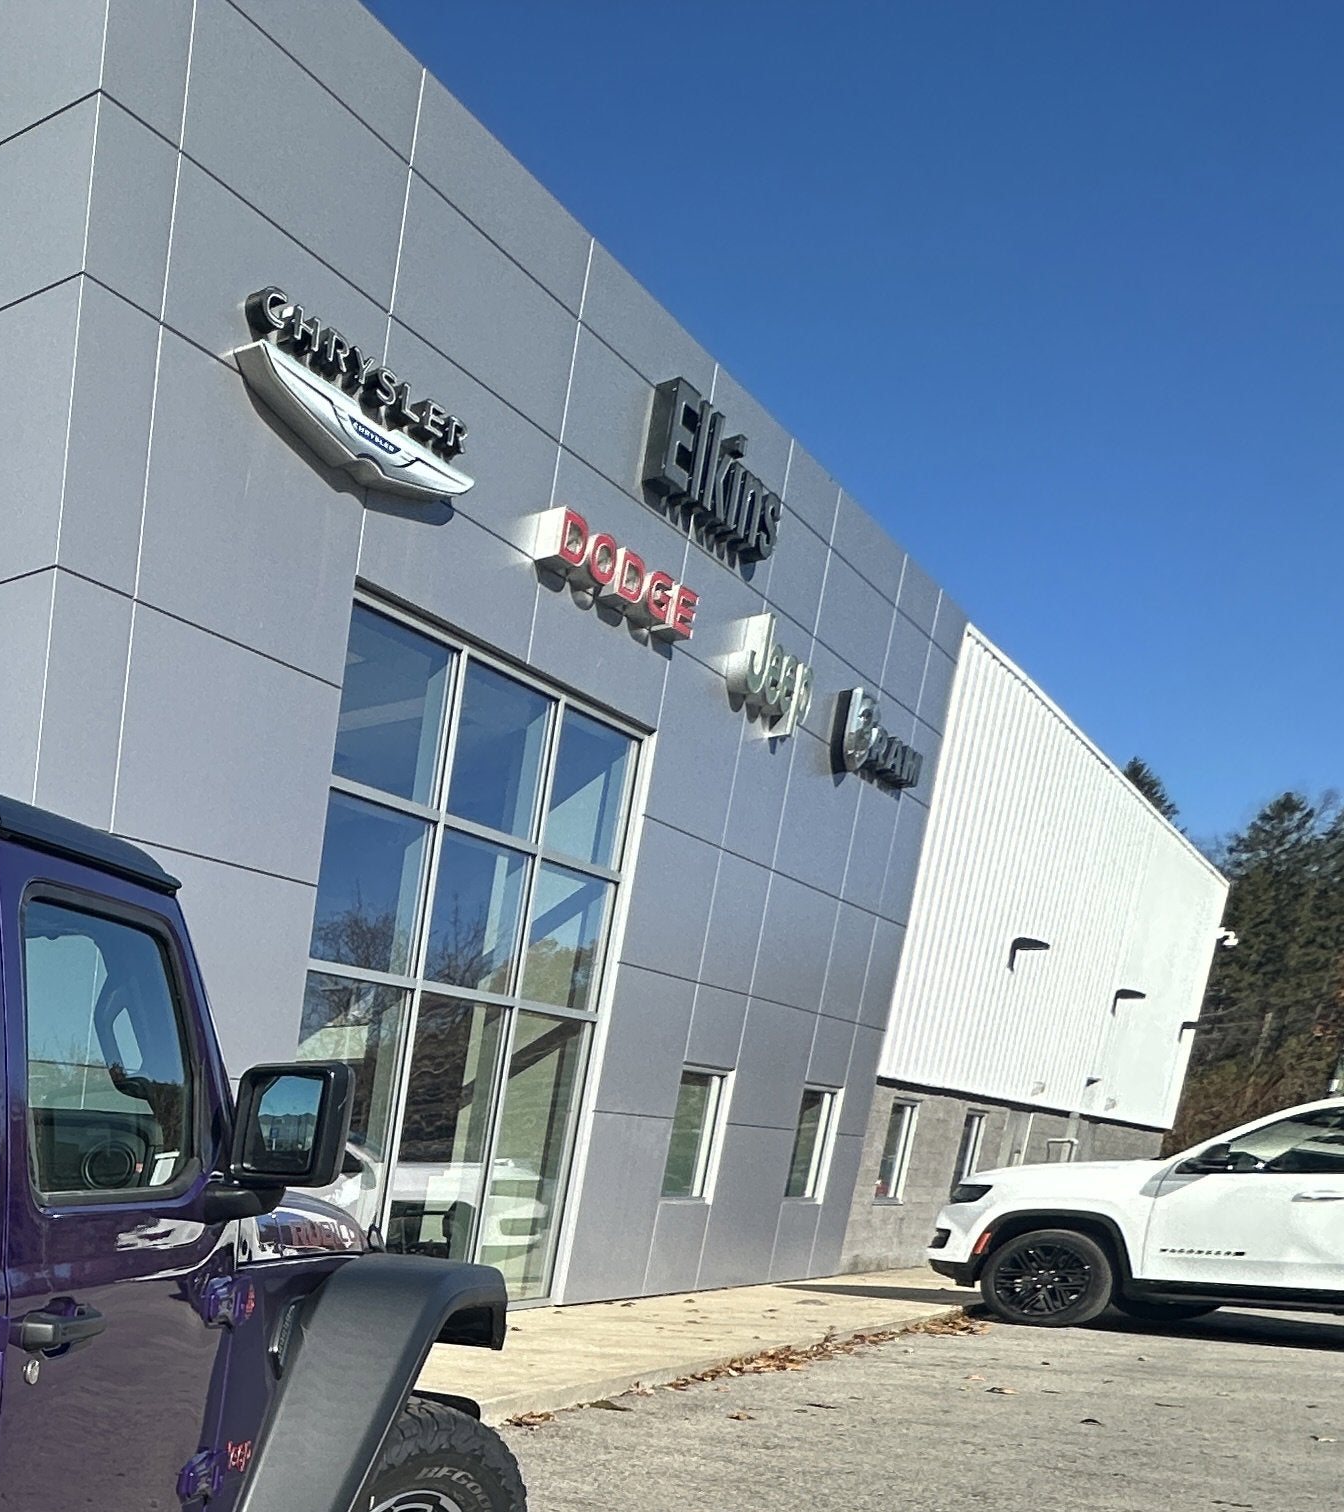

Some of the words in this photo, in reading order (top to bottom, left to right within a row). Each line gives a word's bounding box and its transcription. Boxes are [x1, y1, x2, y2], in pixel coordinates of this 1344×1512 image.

[249, 286, 468, 455] CHRYSLER
[647, 377, 781, 560] Elkins
[547, 506, 700, 641] DODGE
[736, 613, 814, 737] Jeep
[866, 726, 924, 789] RAM
